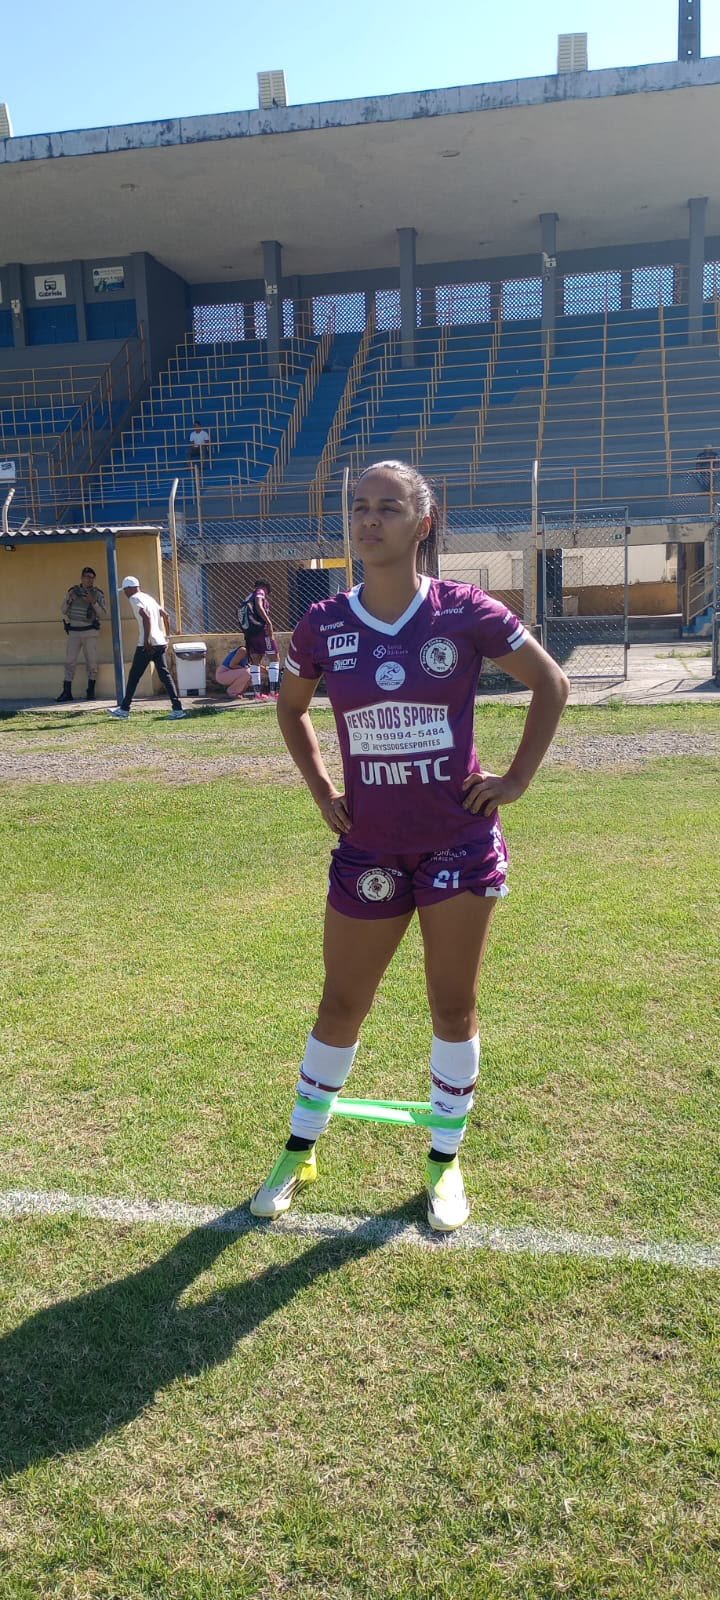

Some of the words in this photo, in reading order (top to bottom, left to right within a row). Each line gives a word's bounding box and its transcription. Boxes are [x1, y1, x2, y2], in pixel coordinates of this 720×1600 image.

[346, 709, 376, 729] REYSS
[377, 706, 401, 730] DOS
[403, 705, 446, 728] SPORTS
[365, 733, 374, 741] 71
[376, 727, 446, 741] 99994-5484
[360, 756, 452, 786] UNIFTC
[433, 869, 460, 889] 21
